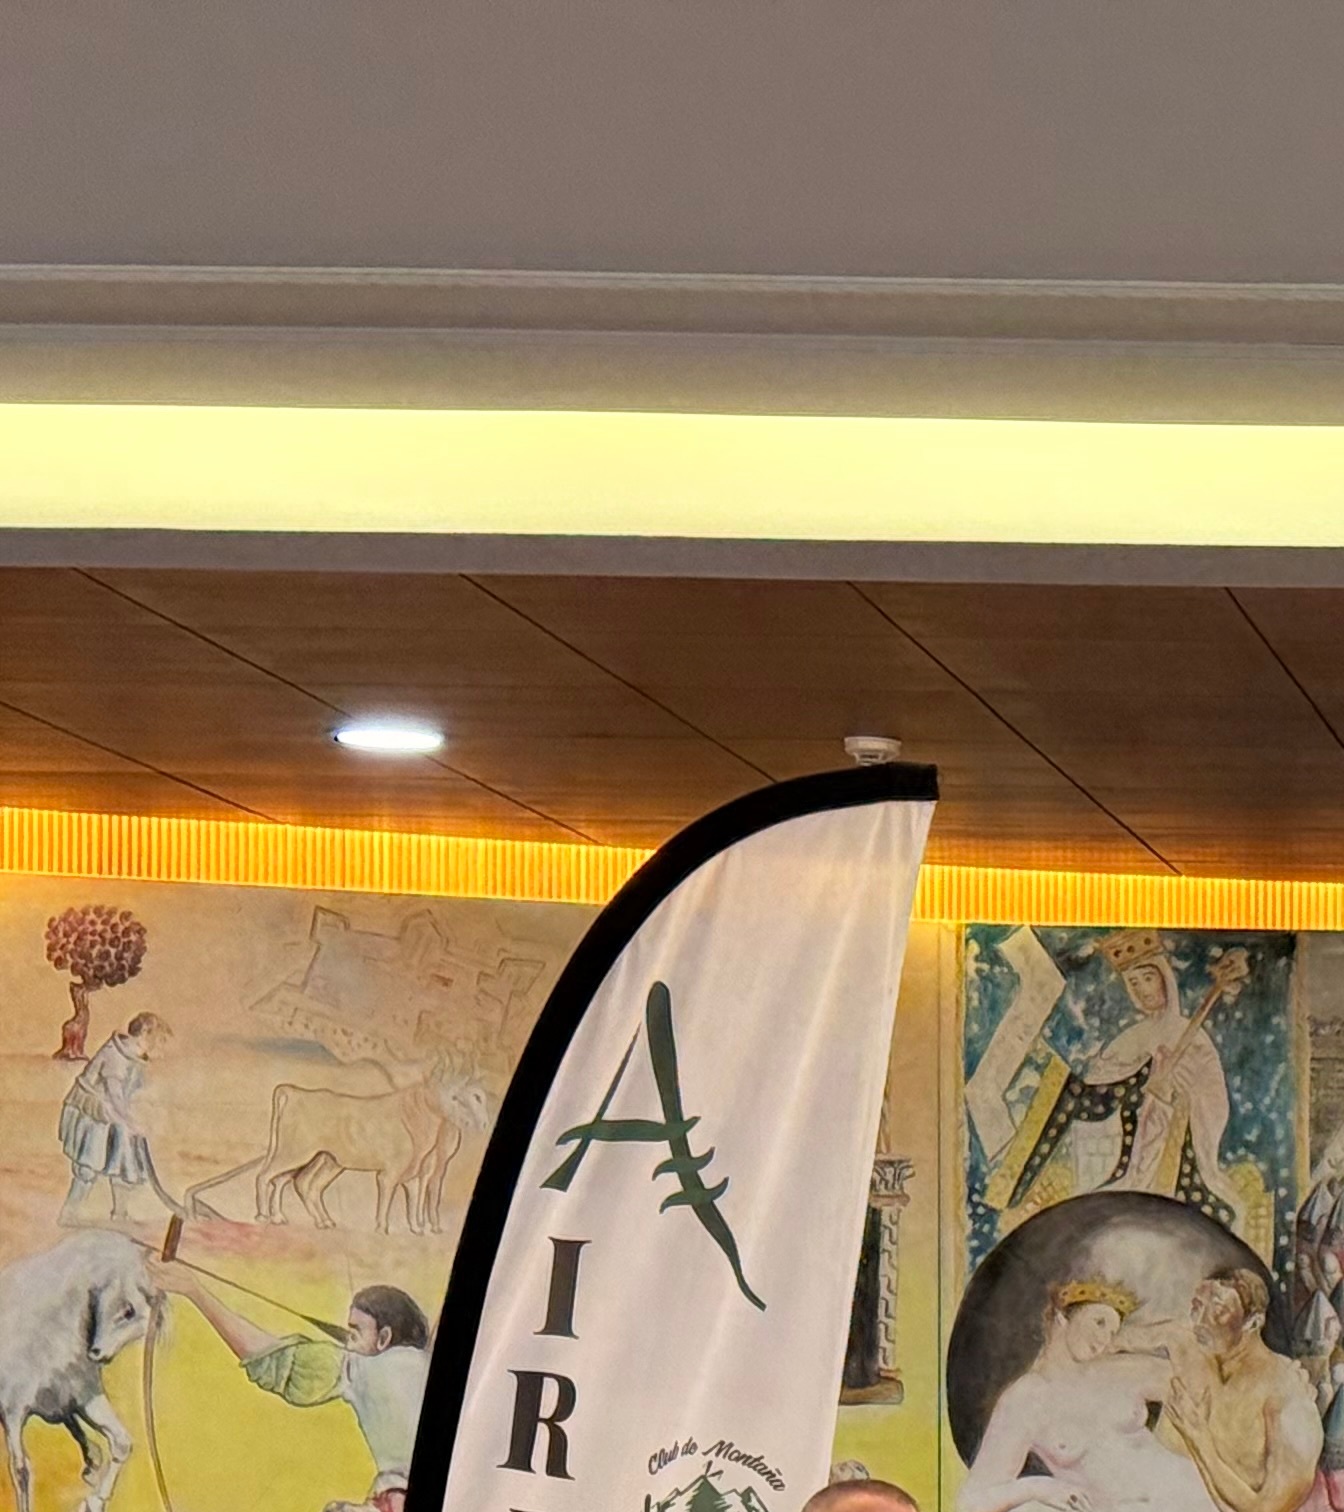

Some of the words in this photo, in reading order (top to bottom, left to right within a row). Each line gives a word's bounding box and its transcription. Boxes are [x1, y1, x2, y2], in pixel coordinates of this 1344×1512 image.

[648, 1440, 679, 1475] Club
[681, 1436, 698, 1456] de
[702, 1440, 786, 1492] Montaña
